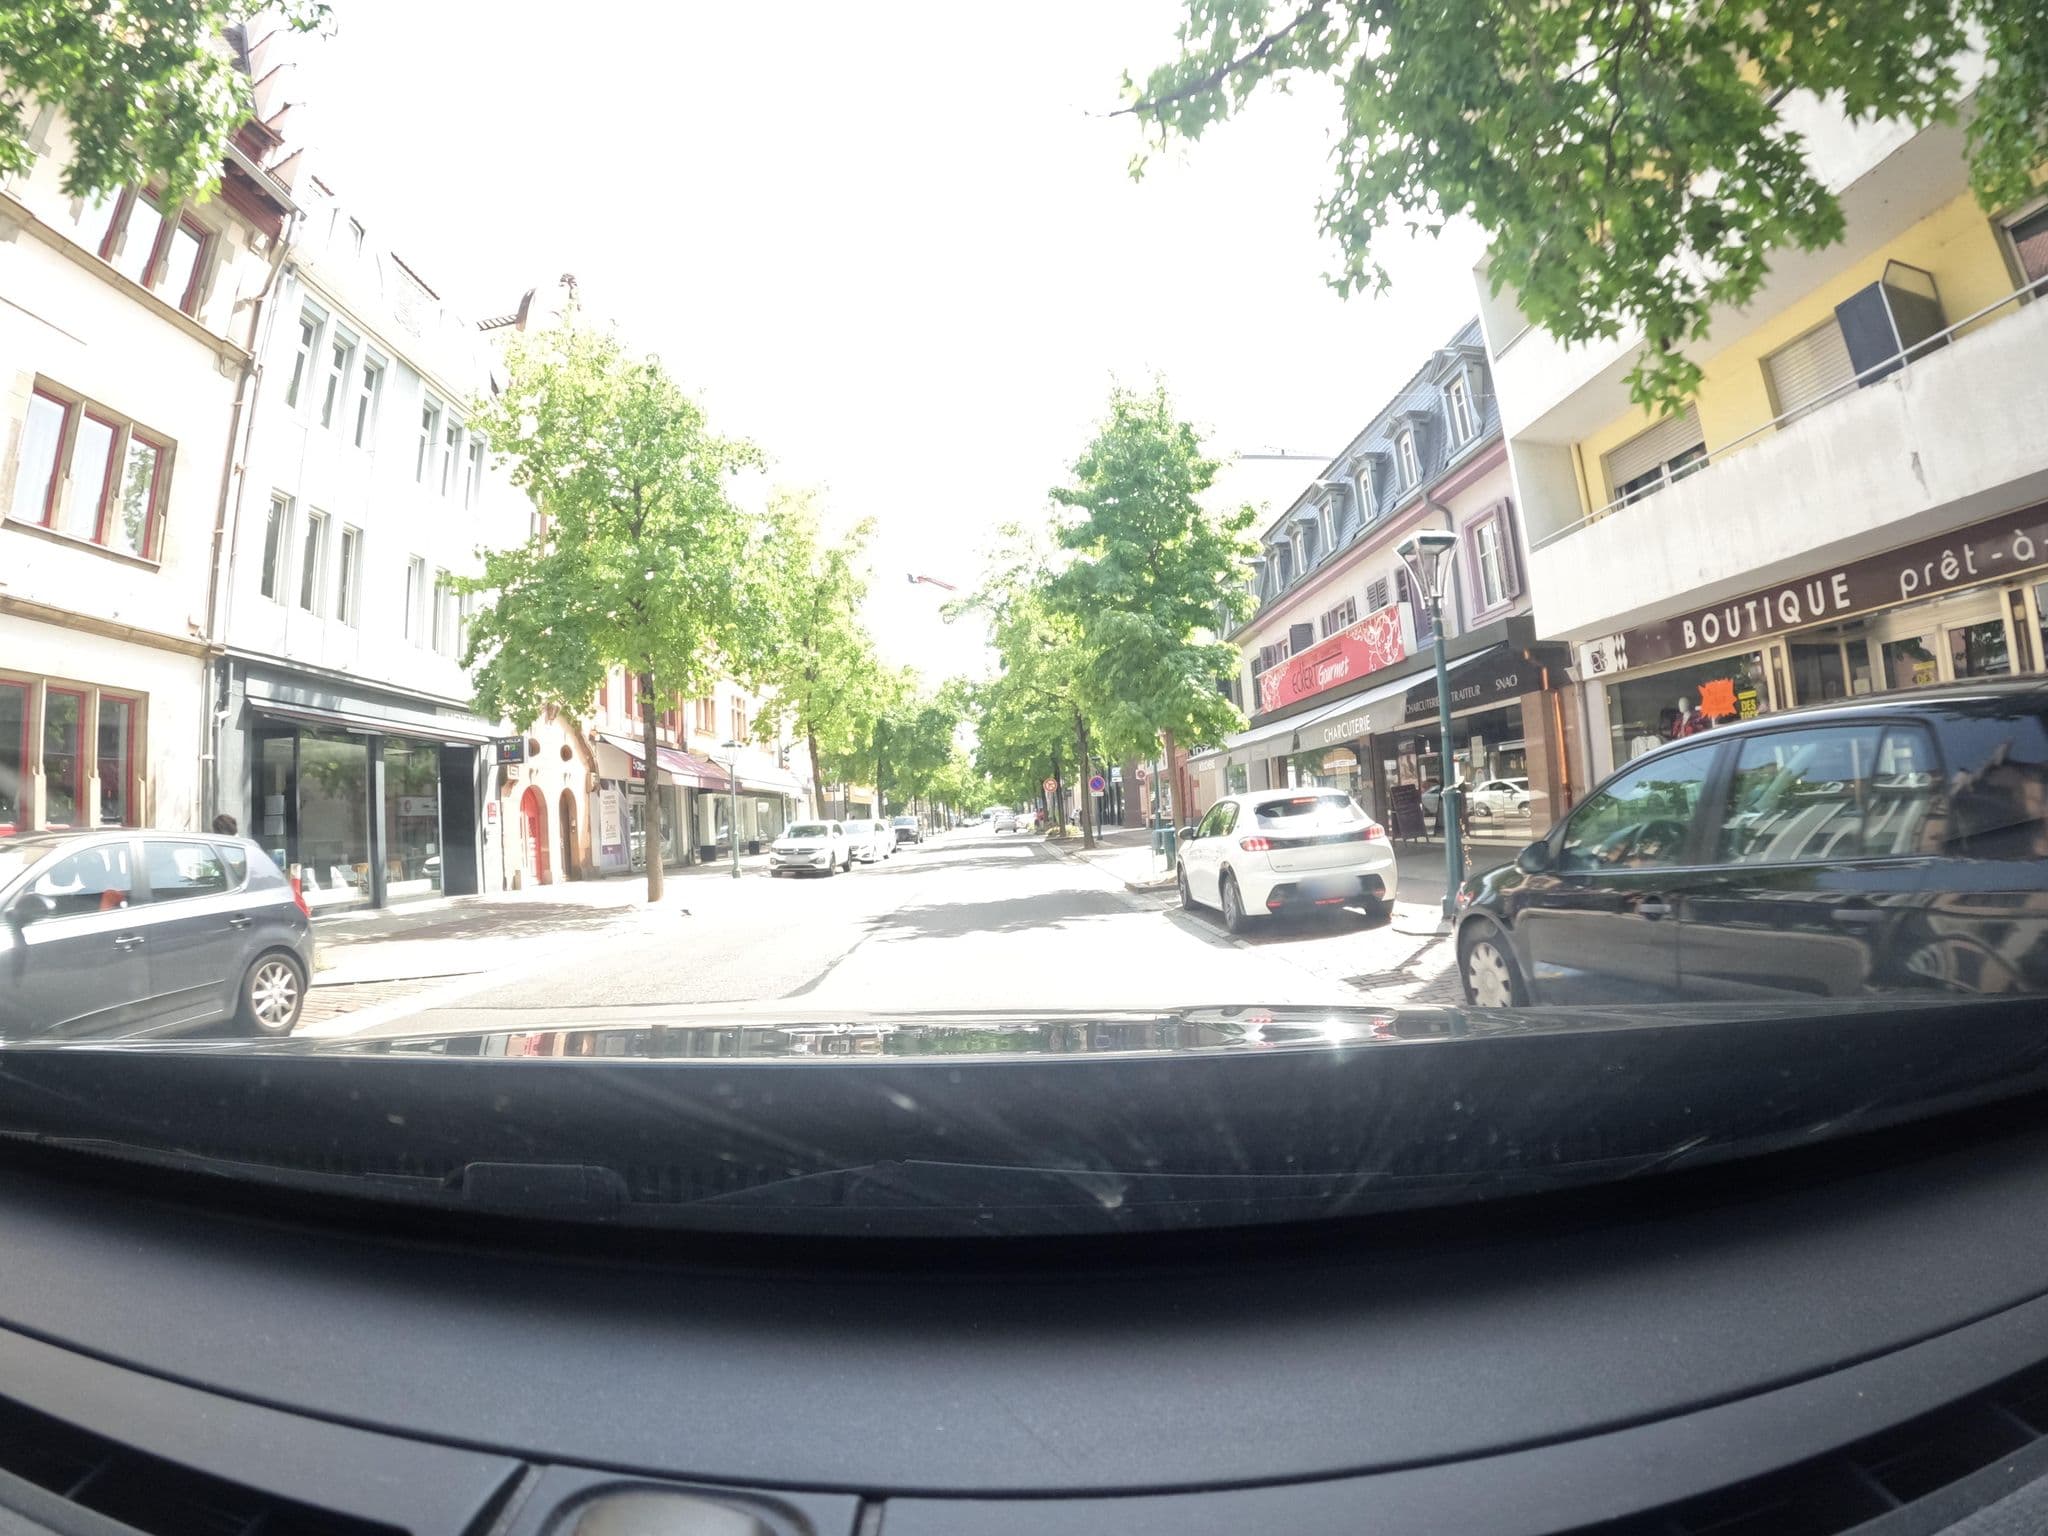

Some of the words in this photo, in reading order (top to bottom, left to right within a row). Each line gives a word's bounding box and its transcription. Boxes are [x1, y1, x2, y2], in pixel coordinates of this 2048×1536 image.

[1682, 573, 1850, 649] BOUTIQUE
[1450, 684, 1481, 702] TRAITEUR
[1323, 714, 1371, 743] CHARCUTERIE
